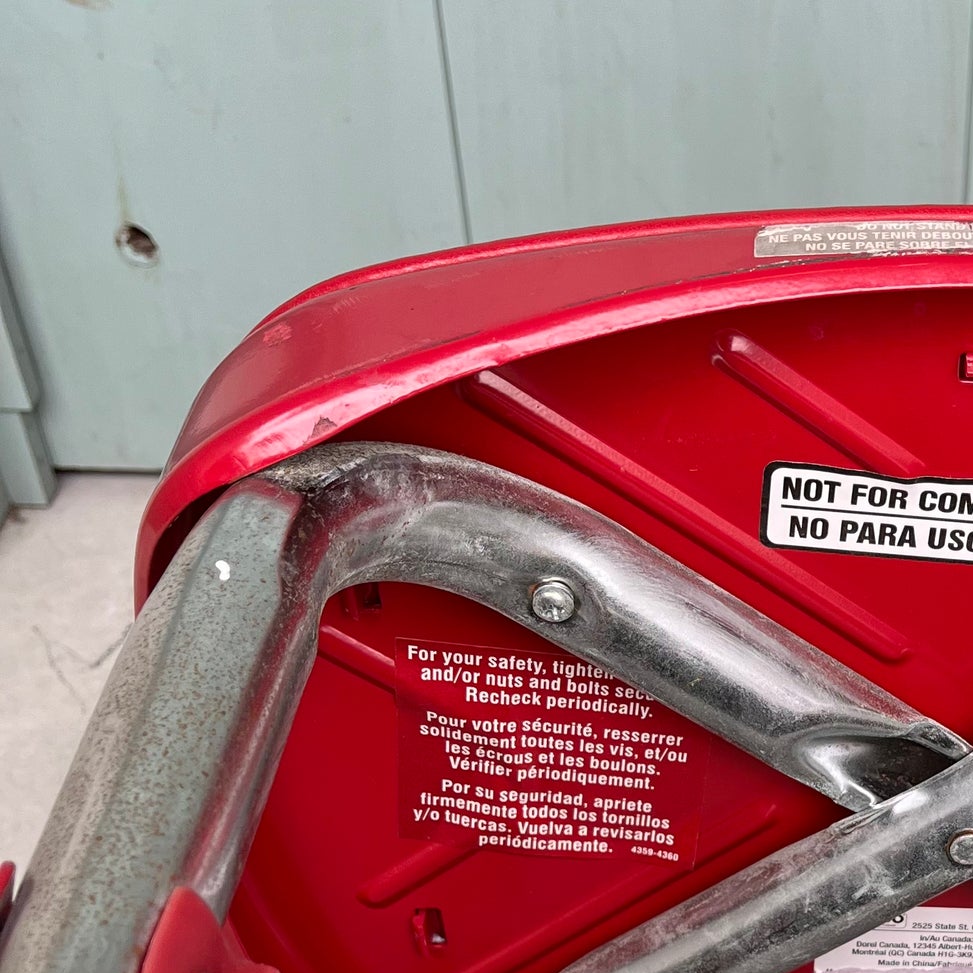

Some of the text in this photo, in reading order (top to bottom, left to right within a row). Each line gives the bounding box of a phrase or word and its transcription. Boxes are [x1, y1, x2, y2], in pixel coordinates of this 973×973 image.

[768, 235, 789, 243] NE
[793, 233, 822, 242] PAS
[827, 232, 868, 241] VOUS
[872, 231, 917, 240] TENIR
[805, 242, 828, 251] NO
[831, 241, 851, 250] SE
[855, 241, 897, 250] PARE
[782, 476, 841, 502] NOT
[851, 485, 908, 509] FOR
[789, 516, 829, 539] NO
[839, 520, 917, 548] PARA
[407, 645, 437, 662] For
[442, 651, 483, 667] your
[488, 655, 547, 675] safety,
[421, 665, 480, 684] and/or
[486, 671, 523, 688] nuts
[529, 675, 560, 692] and
[567, 678, 609, 697] bolts
[465, 687, 653, 719] Recheck periodically.
[420, 723, 688, 763] solidement toutes les vis, et/ou
[426, 711, 683, 747] Pour votre sécurité, resserrer
[445, 741, 661, 776] les écrous et les boulons.
[449, 756, 655, 791] Vérifier périodiquement.
[420, 792, 670, 830] firmemente todos los tornillos
[441, 779, 652, 814] Por su seguridad, apriete
[413, 806, 675, 846] y/o tuercas. Vuelva a revisarlos
[479, 834, 679, 862] periódicamente. 4359-4360
[852, 948, 887, 956] Montréal
[879, 941, 910, 949] Canada,
